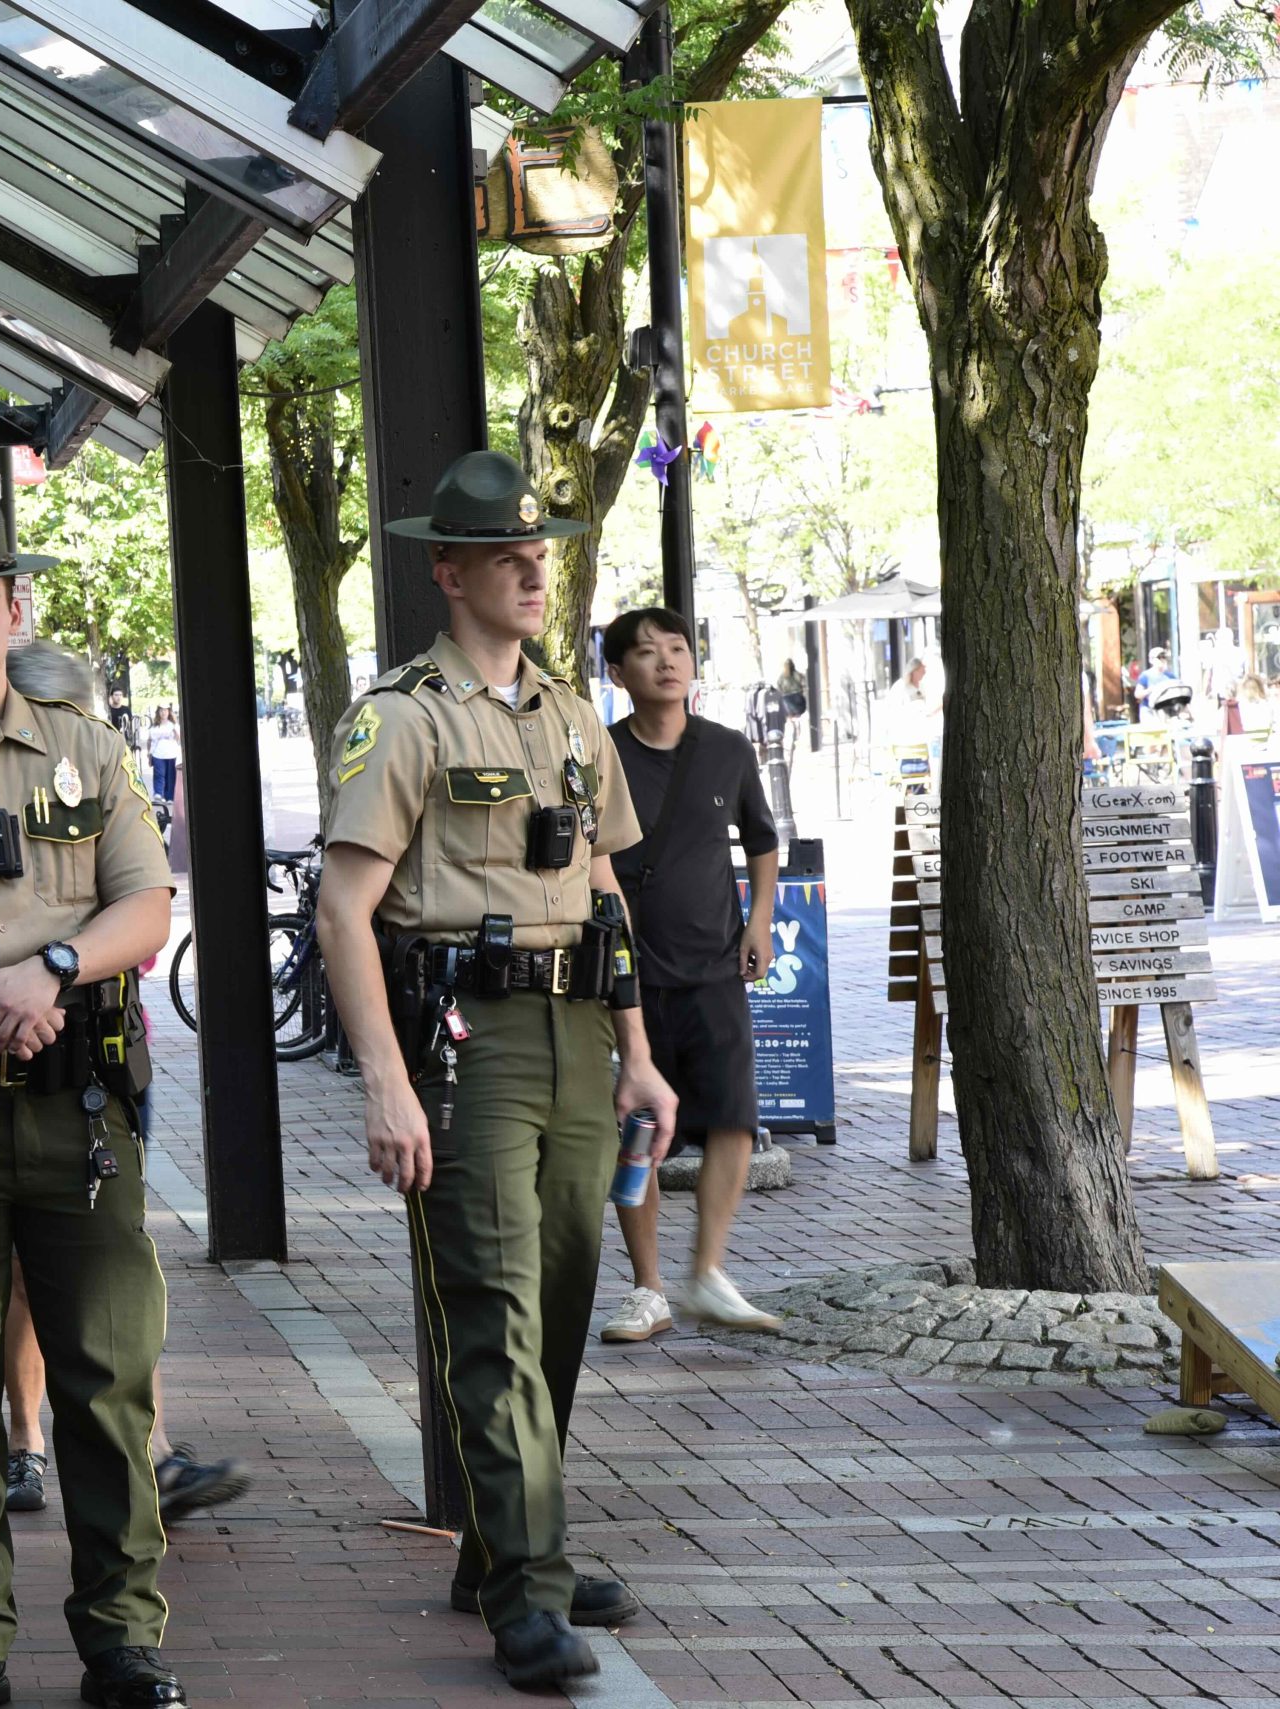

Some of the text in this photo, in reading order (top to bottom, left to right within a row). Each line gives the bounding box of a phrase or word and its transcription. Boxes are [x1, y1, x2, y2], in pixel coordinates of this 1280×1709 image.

[706, 341, 812, 363] CHURCH
[707, 362, 813, 383] STREET
[1092, 791, 1176, 808] (GearX.com)
[1100, 849, 1185, 863] FOOTWEAR
[1131, 878, 1155, 889] SKI
[1123, 903, 1165, 916] CAMP
[1139, 930, 1180, 943] SHOP
[1110, 958, 1173, 972] SAVINGS
[1098, 986, 1177, 1000] SINCE 1995
